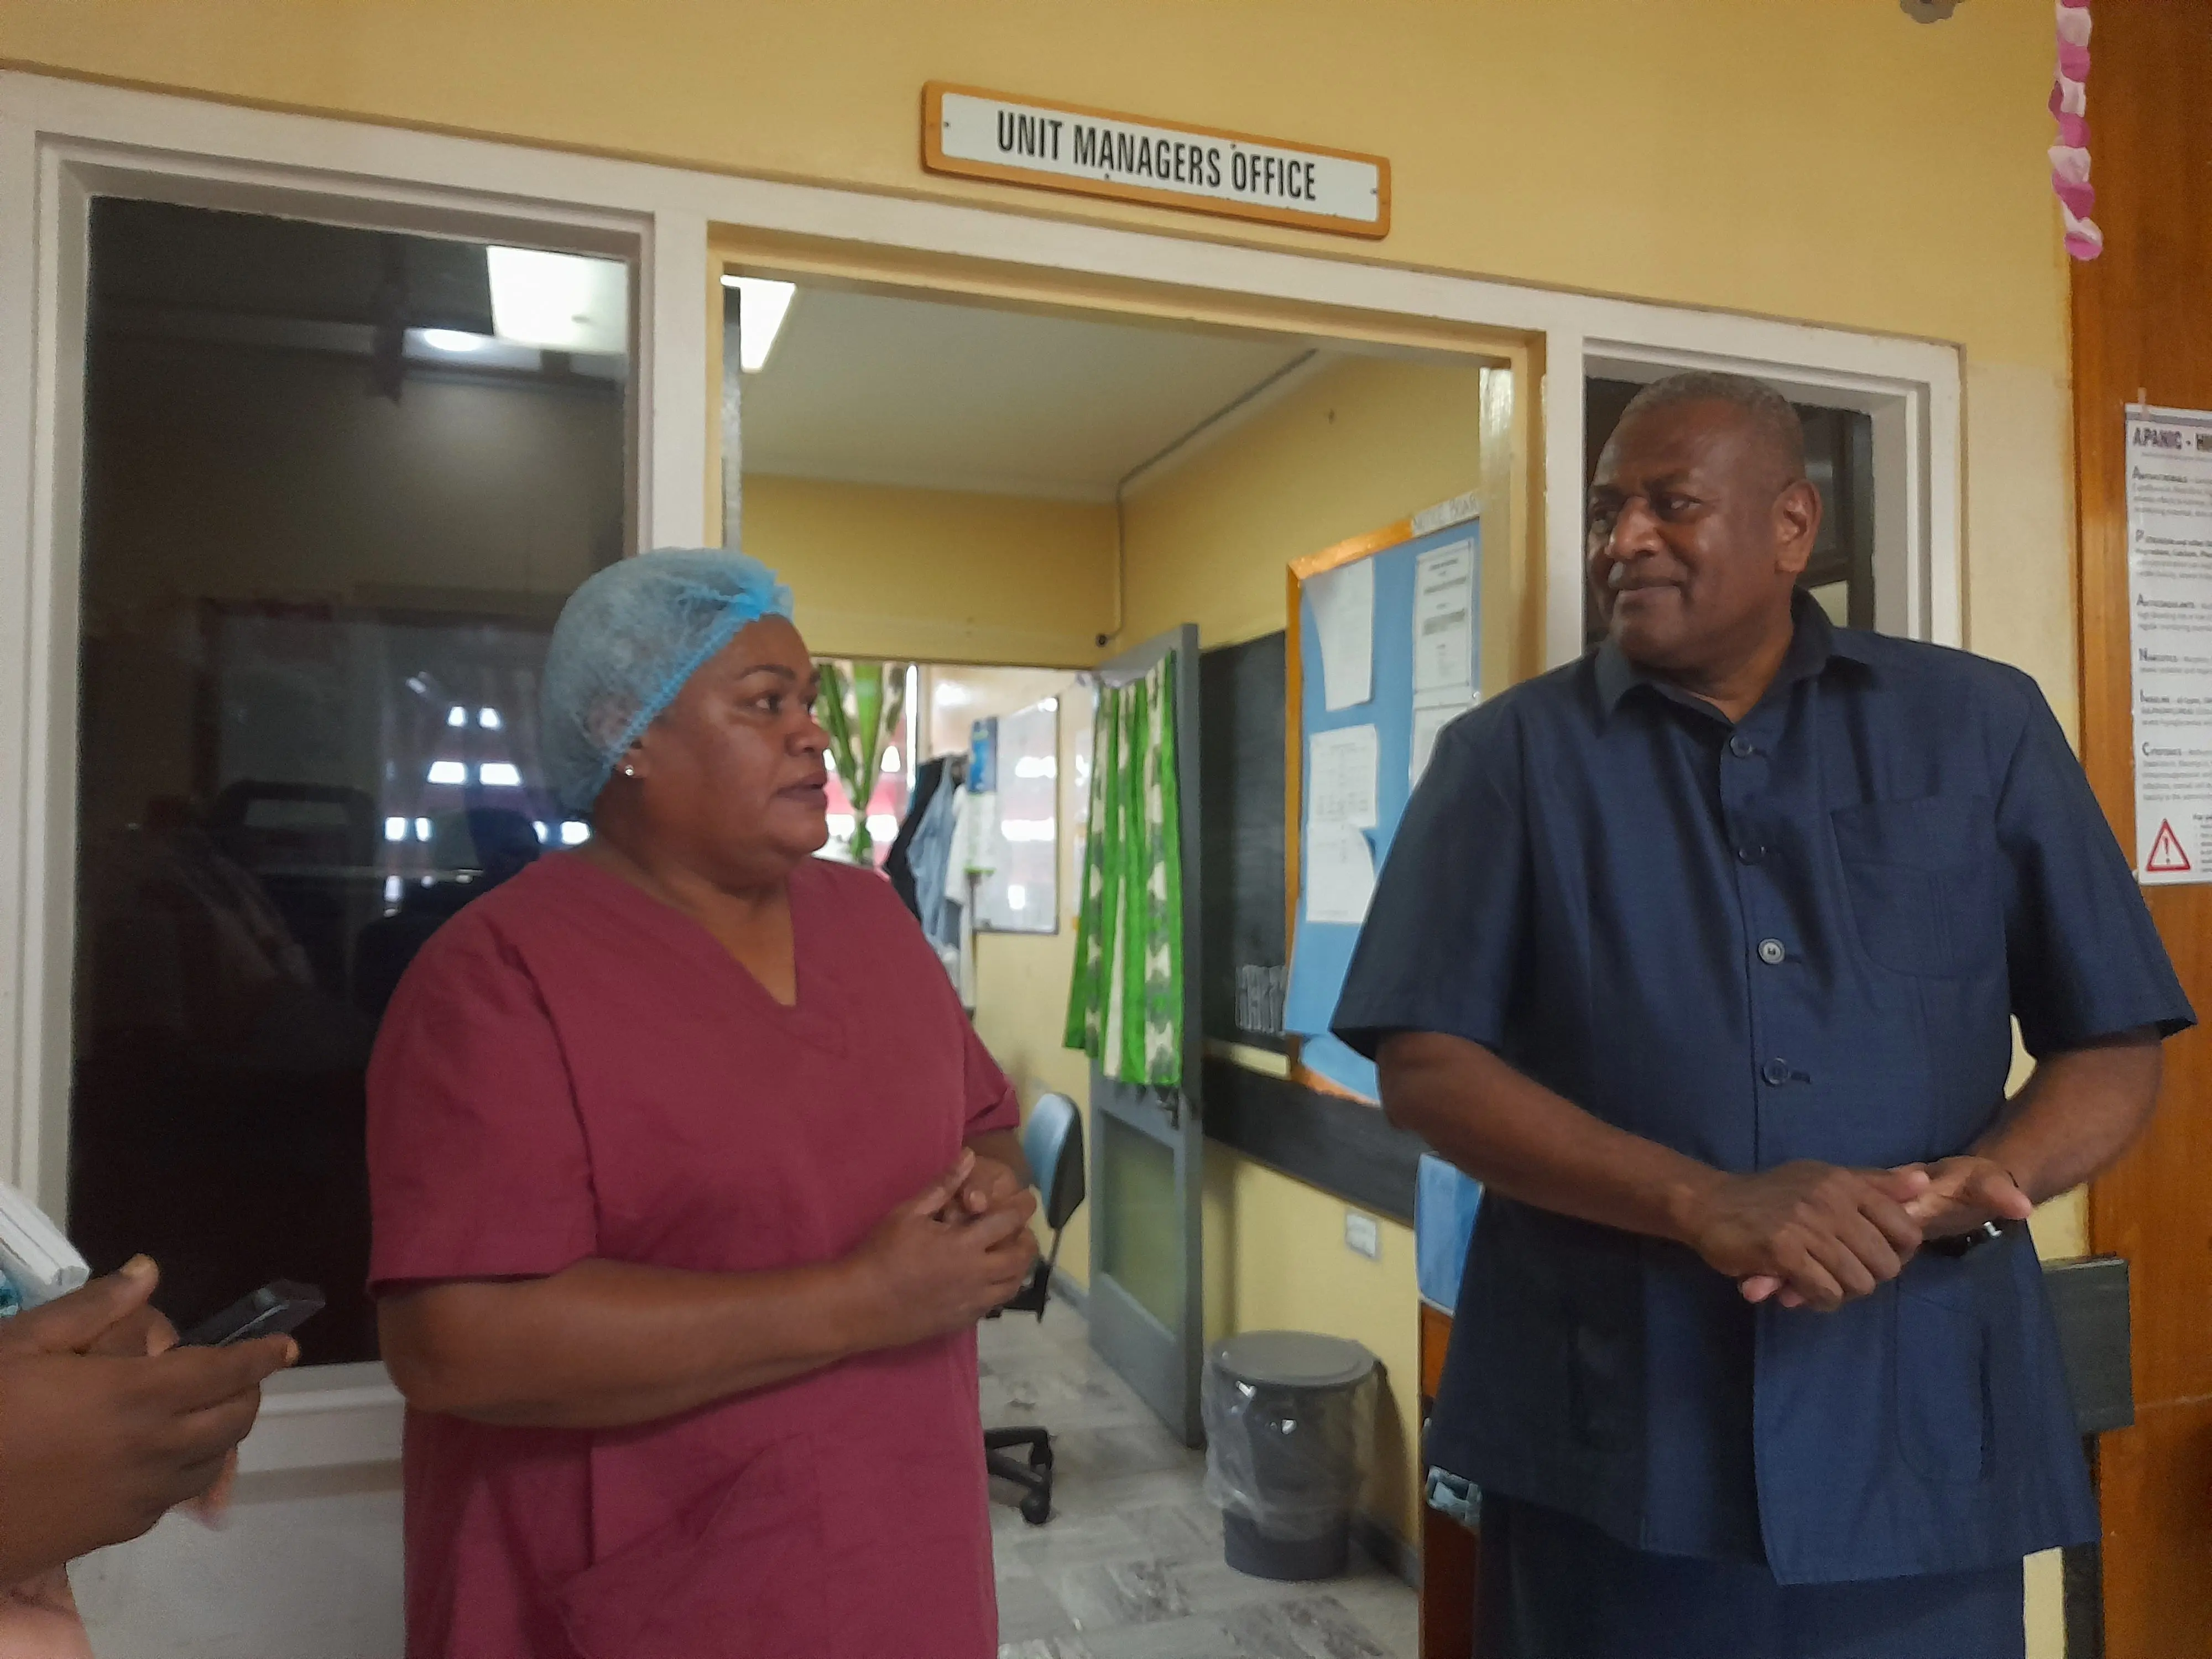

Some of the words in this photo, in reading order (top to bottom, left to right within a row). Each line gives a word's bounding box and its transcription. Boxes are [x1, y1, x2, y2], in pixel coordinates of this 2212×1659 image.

[998, 110, 1063, 161] UNIT
[1073, 124, 1220, 187] MANAGERS
[1231, 151, 1316, 201] OFFICE
